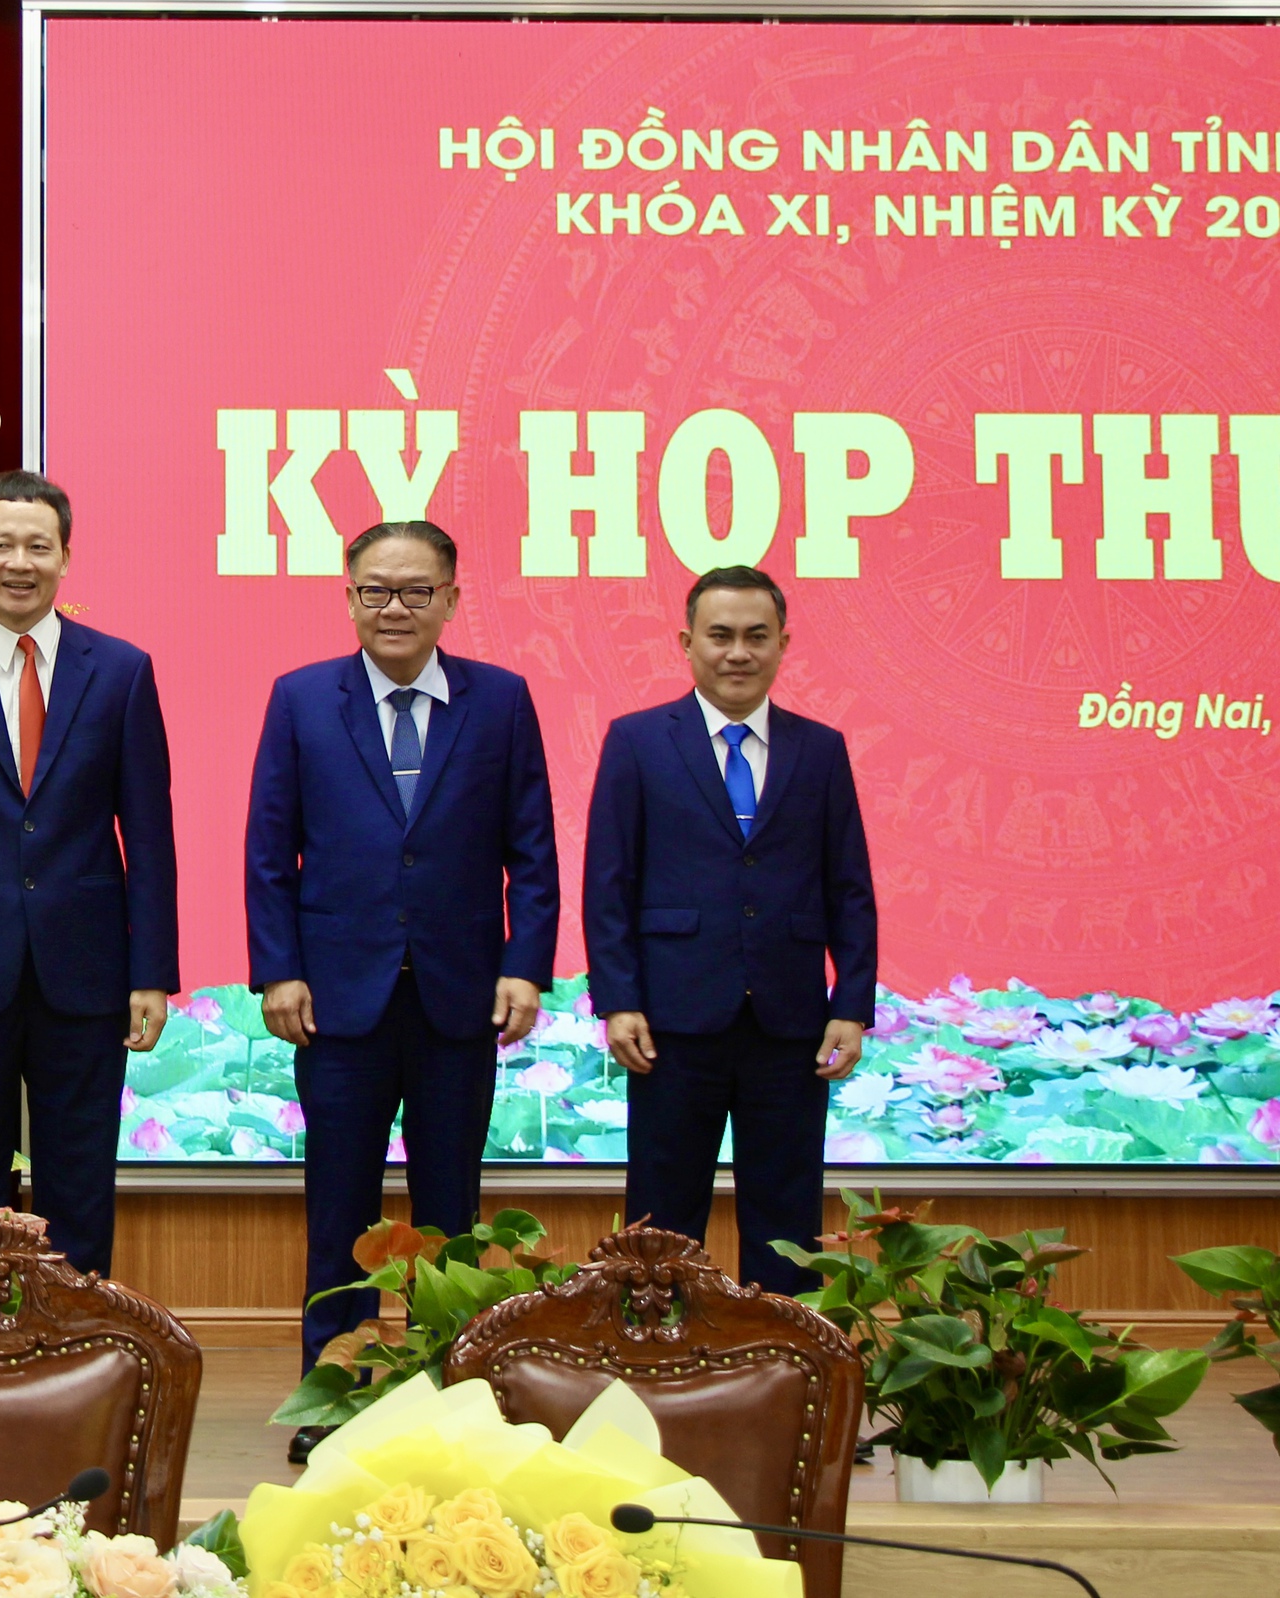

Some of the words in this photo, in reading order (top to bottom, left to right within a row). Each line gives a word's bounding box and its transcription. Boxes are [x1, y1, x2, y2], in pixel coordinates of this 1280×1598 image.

[438, 115, 556, 184] HỘI
[577, 106, 781, 173] ĐỒNG
[801, 117, 989, 173] NHÂN
[1010, 118, 1150, 174] DÂN
[1170, 114, 1280, 174] TỈN
[555, 179, 746, 237] KHÓA
[765, 193, 851, 246] XI,
[873, 182, 1077, 251] NHIỆM
[1101, 182, 1183, 239] KỲ
[1204, 194, 1280, 240] 20
[215, 367, 461, 577] KỲ
[1077, 680, 1185, 741] Đồng
[1193, 692, 1272, 737] Nai,
